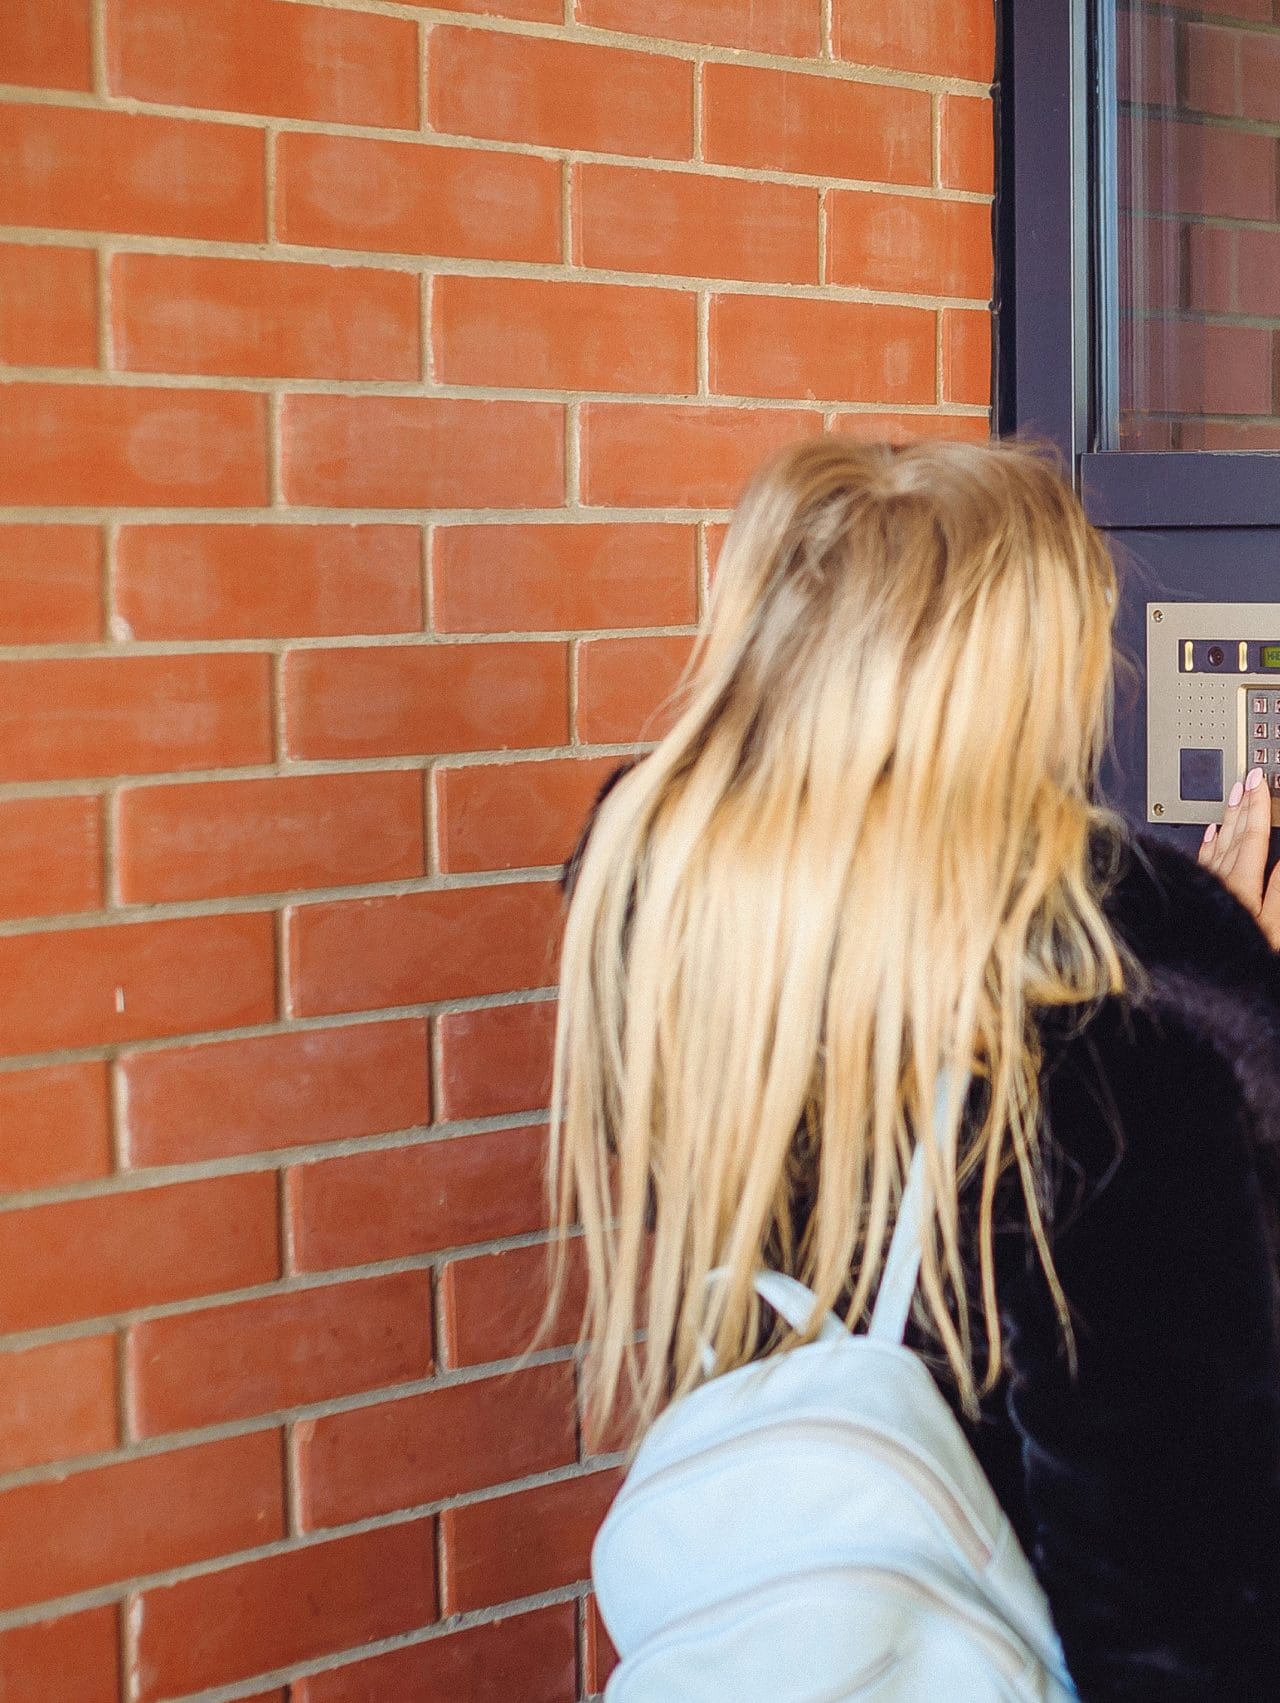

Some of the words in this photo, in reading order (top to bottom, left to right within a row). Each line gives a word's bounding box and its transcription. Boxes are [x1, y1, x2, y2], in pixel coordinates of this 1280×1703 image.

[1256, 700, 1264, 711] 1
[1256, 725, 1264, 736] 4
[1256, 749, 1264, 760] 7
